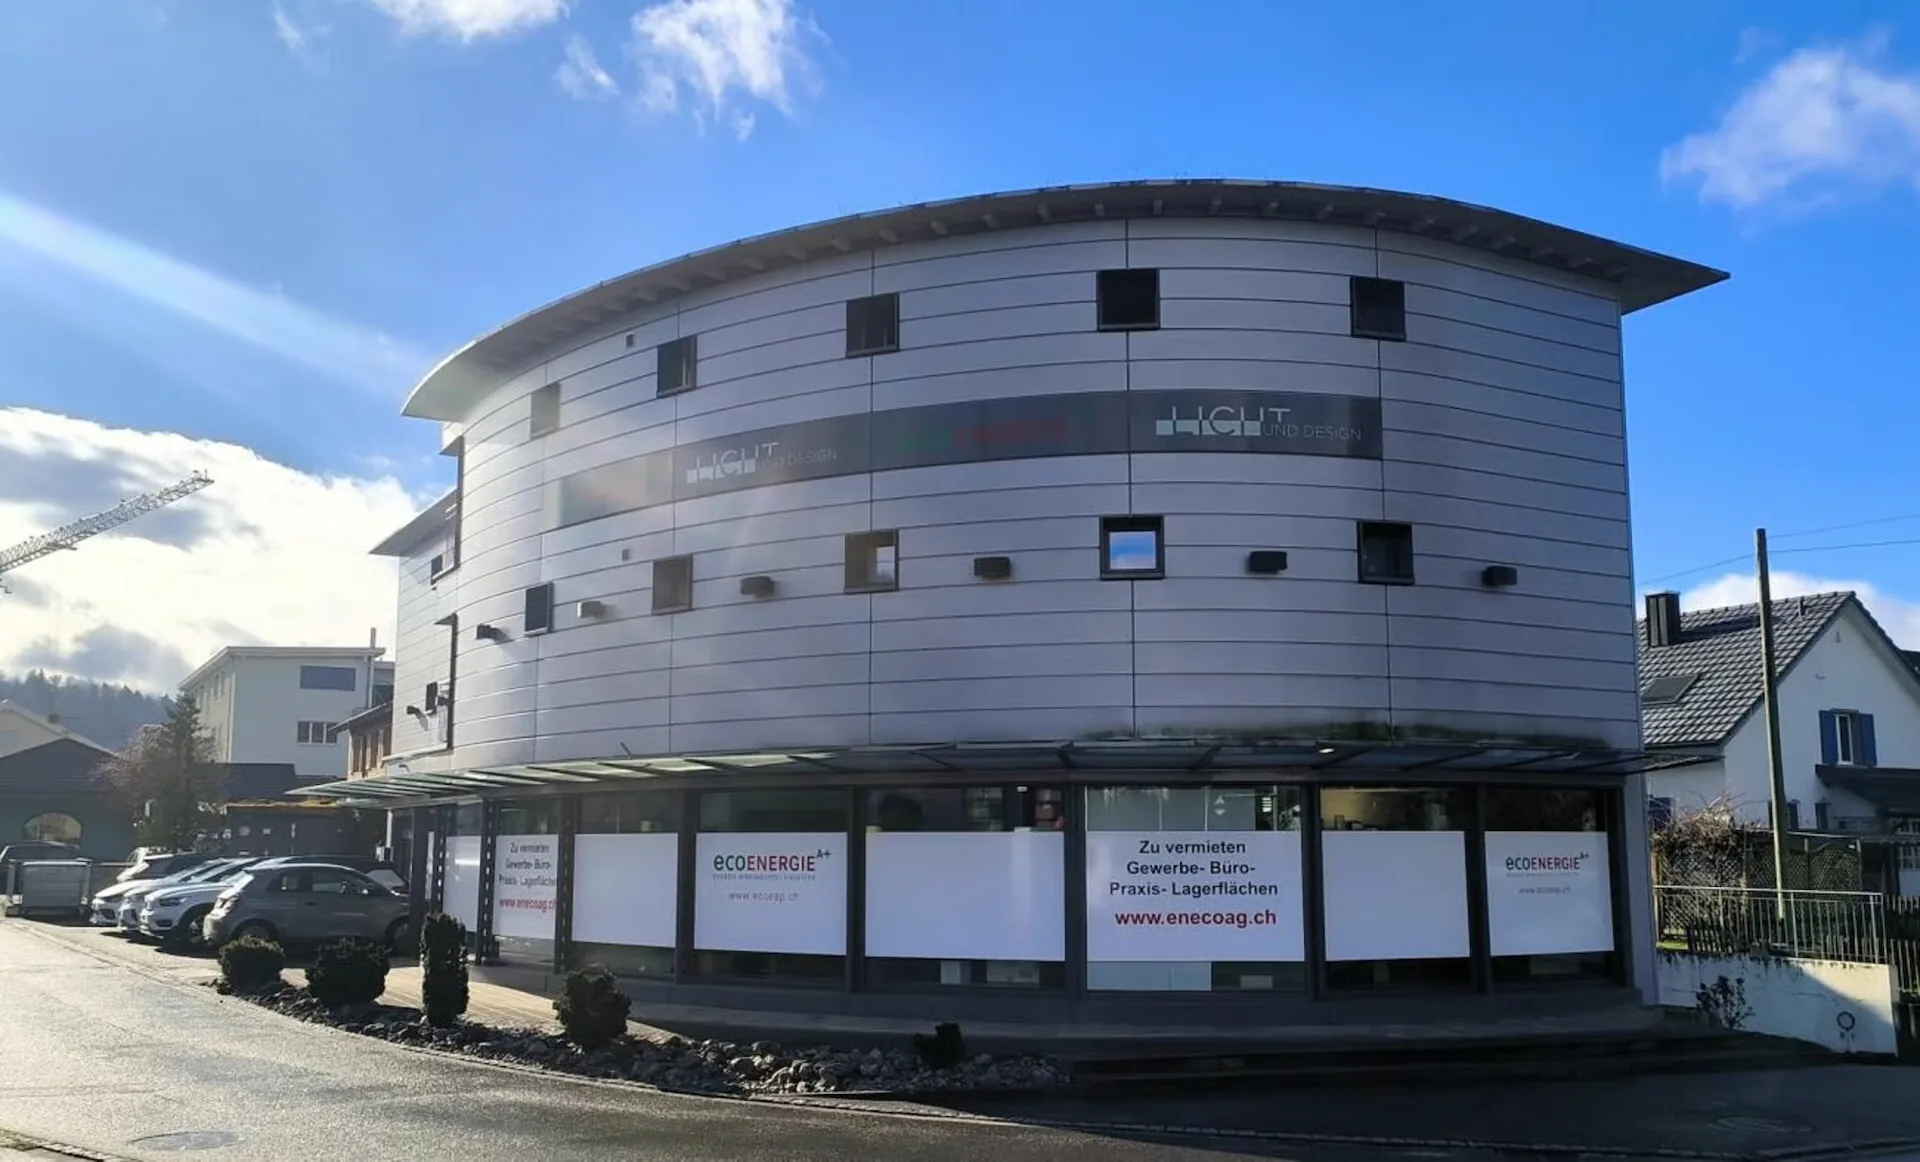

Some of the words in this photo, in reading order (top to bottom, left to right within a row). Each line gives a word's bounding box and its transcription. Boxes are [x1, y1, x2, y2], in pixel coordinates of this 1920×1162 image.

[1156, 405, 1291, 436] LICHT
[1263, 423, 1299, 437] UND
[1303, 425, 1363, 440] DESIGN
[685, 442, 780, 485] LICHT
[1139, 840, 1160, 854] Zu
[1165, 840, 1246, 854] vermieten
[1126, 861, 1205, 875] Gewerbe-
[1210, 860, 1256, 875] Büro-
[1109, 882, 1167, 896] Praxis-
[1172, 881, 1278, 898] Lagerflächen
[1115, 909, 1277, 929] www.enecoag.ch
